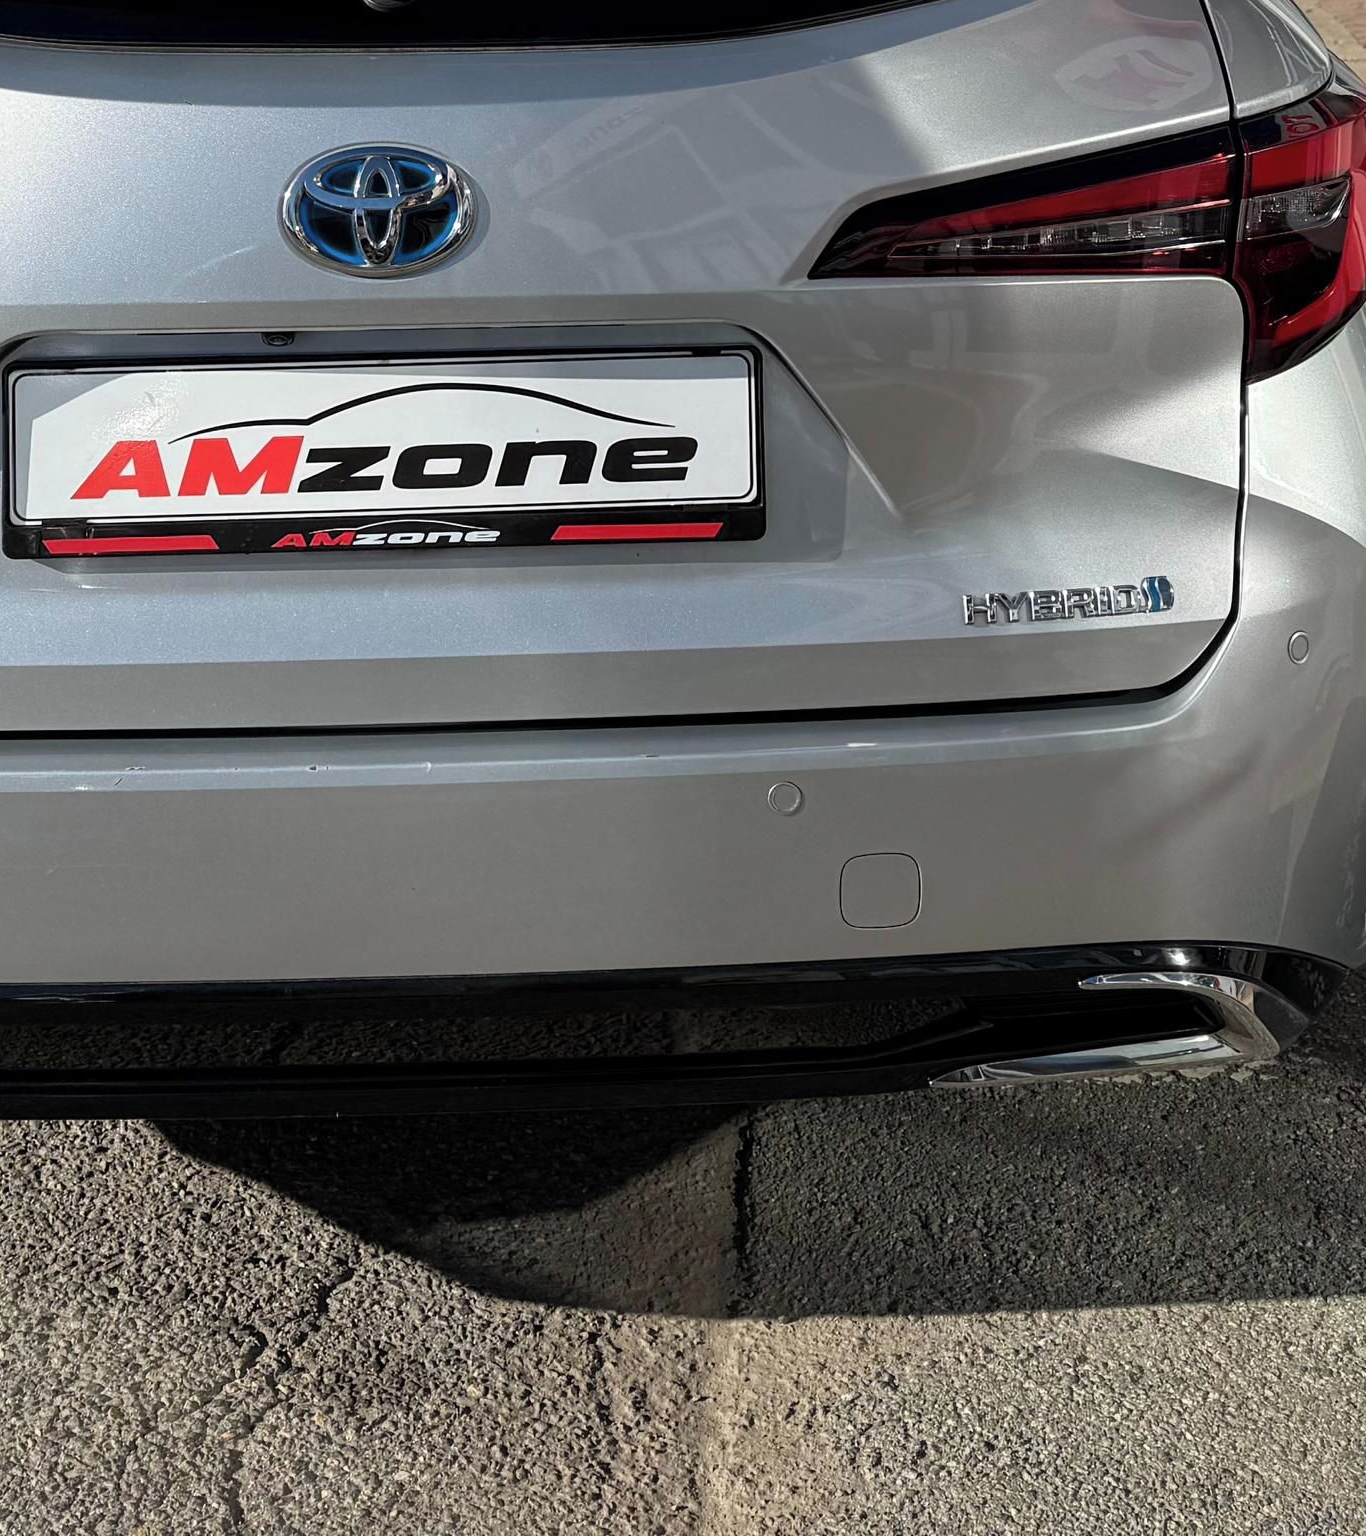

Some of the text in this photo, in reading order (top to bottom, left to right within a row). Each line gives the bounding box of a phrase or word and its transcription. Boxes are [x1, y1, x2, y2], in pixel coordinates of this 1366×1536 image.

[70, 435, 698, 500] AMzone
[271, 530, 501, 548] AMzone
[962, 585, 1141, 625] HYBRID
